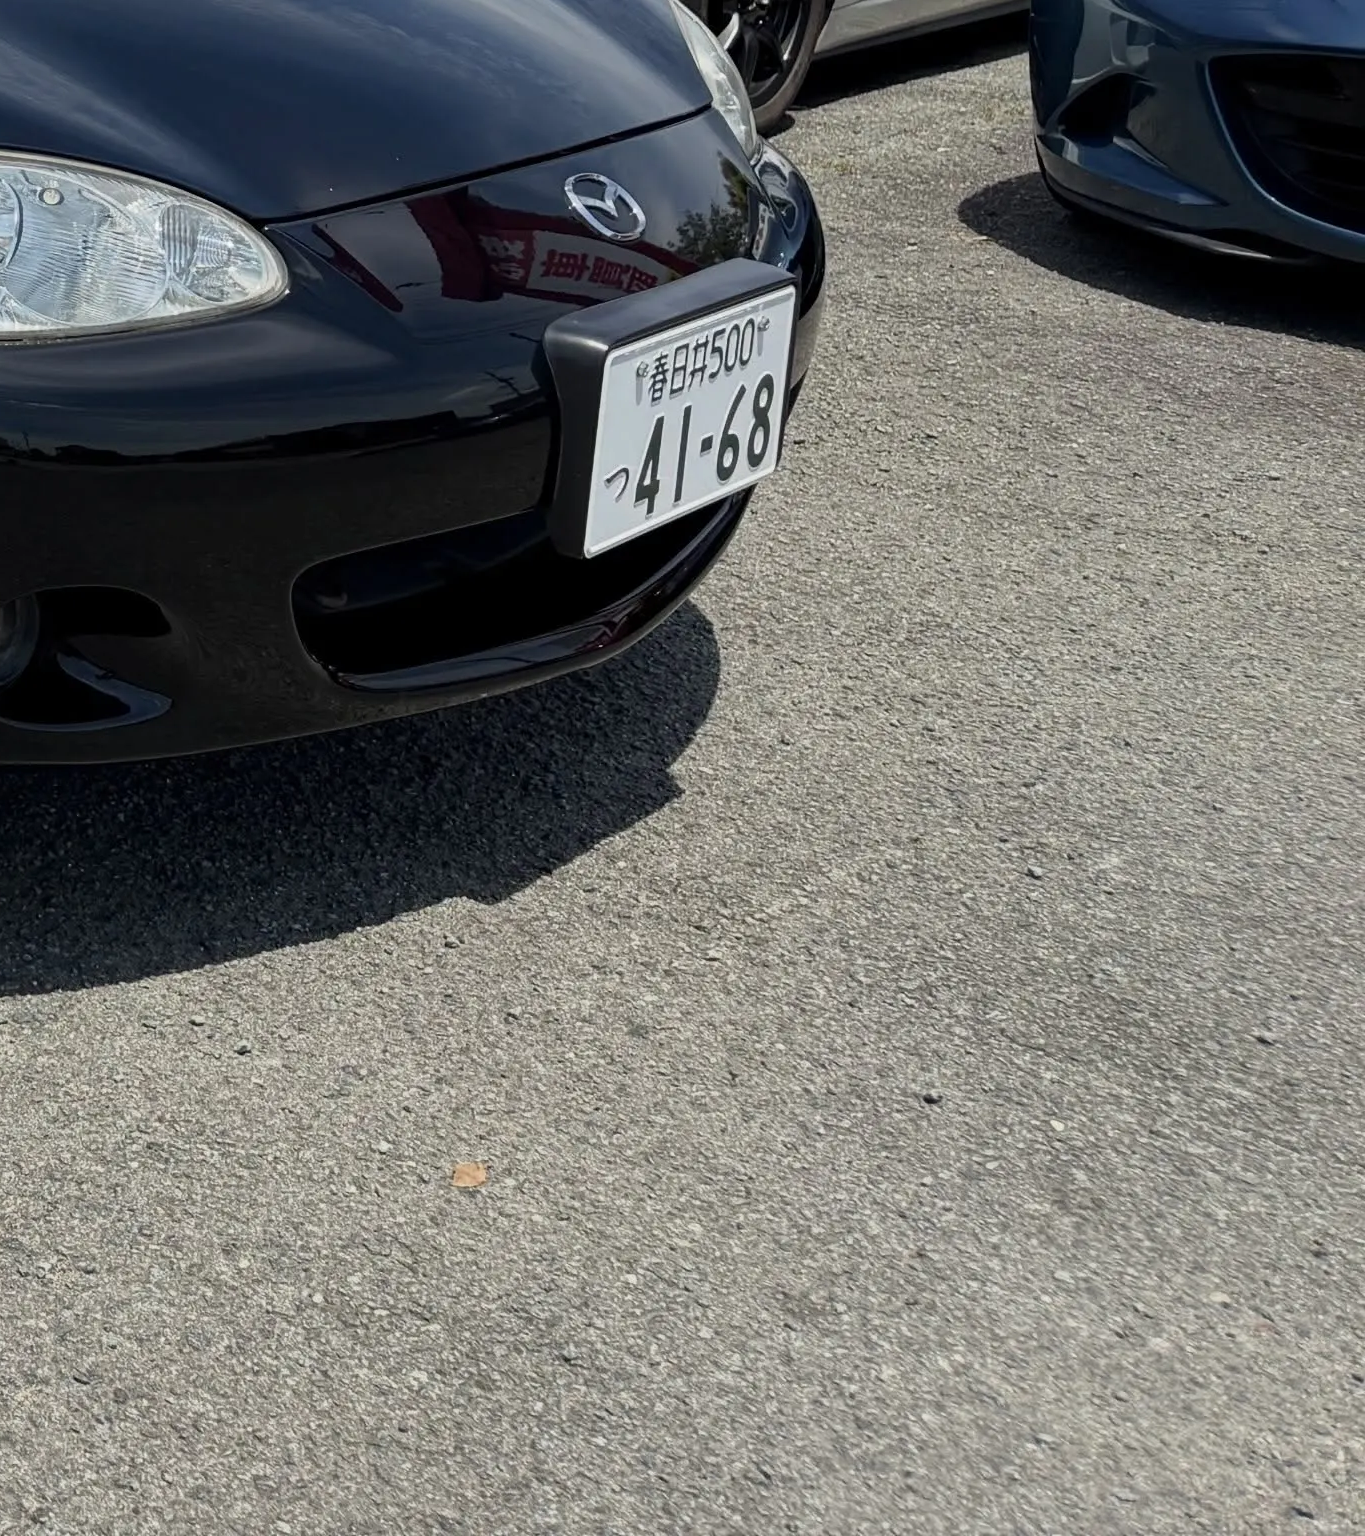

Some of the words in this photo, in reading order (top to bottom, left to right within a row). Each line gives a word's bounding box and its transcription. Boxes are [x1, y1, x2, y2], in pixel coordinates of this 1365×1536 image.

[647, 318, 755, 405] 春日井500
[604, 466, 629, 501] つ
[634, 373, 774, 517] 41-68
